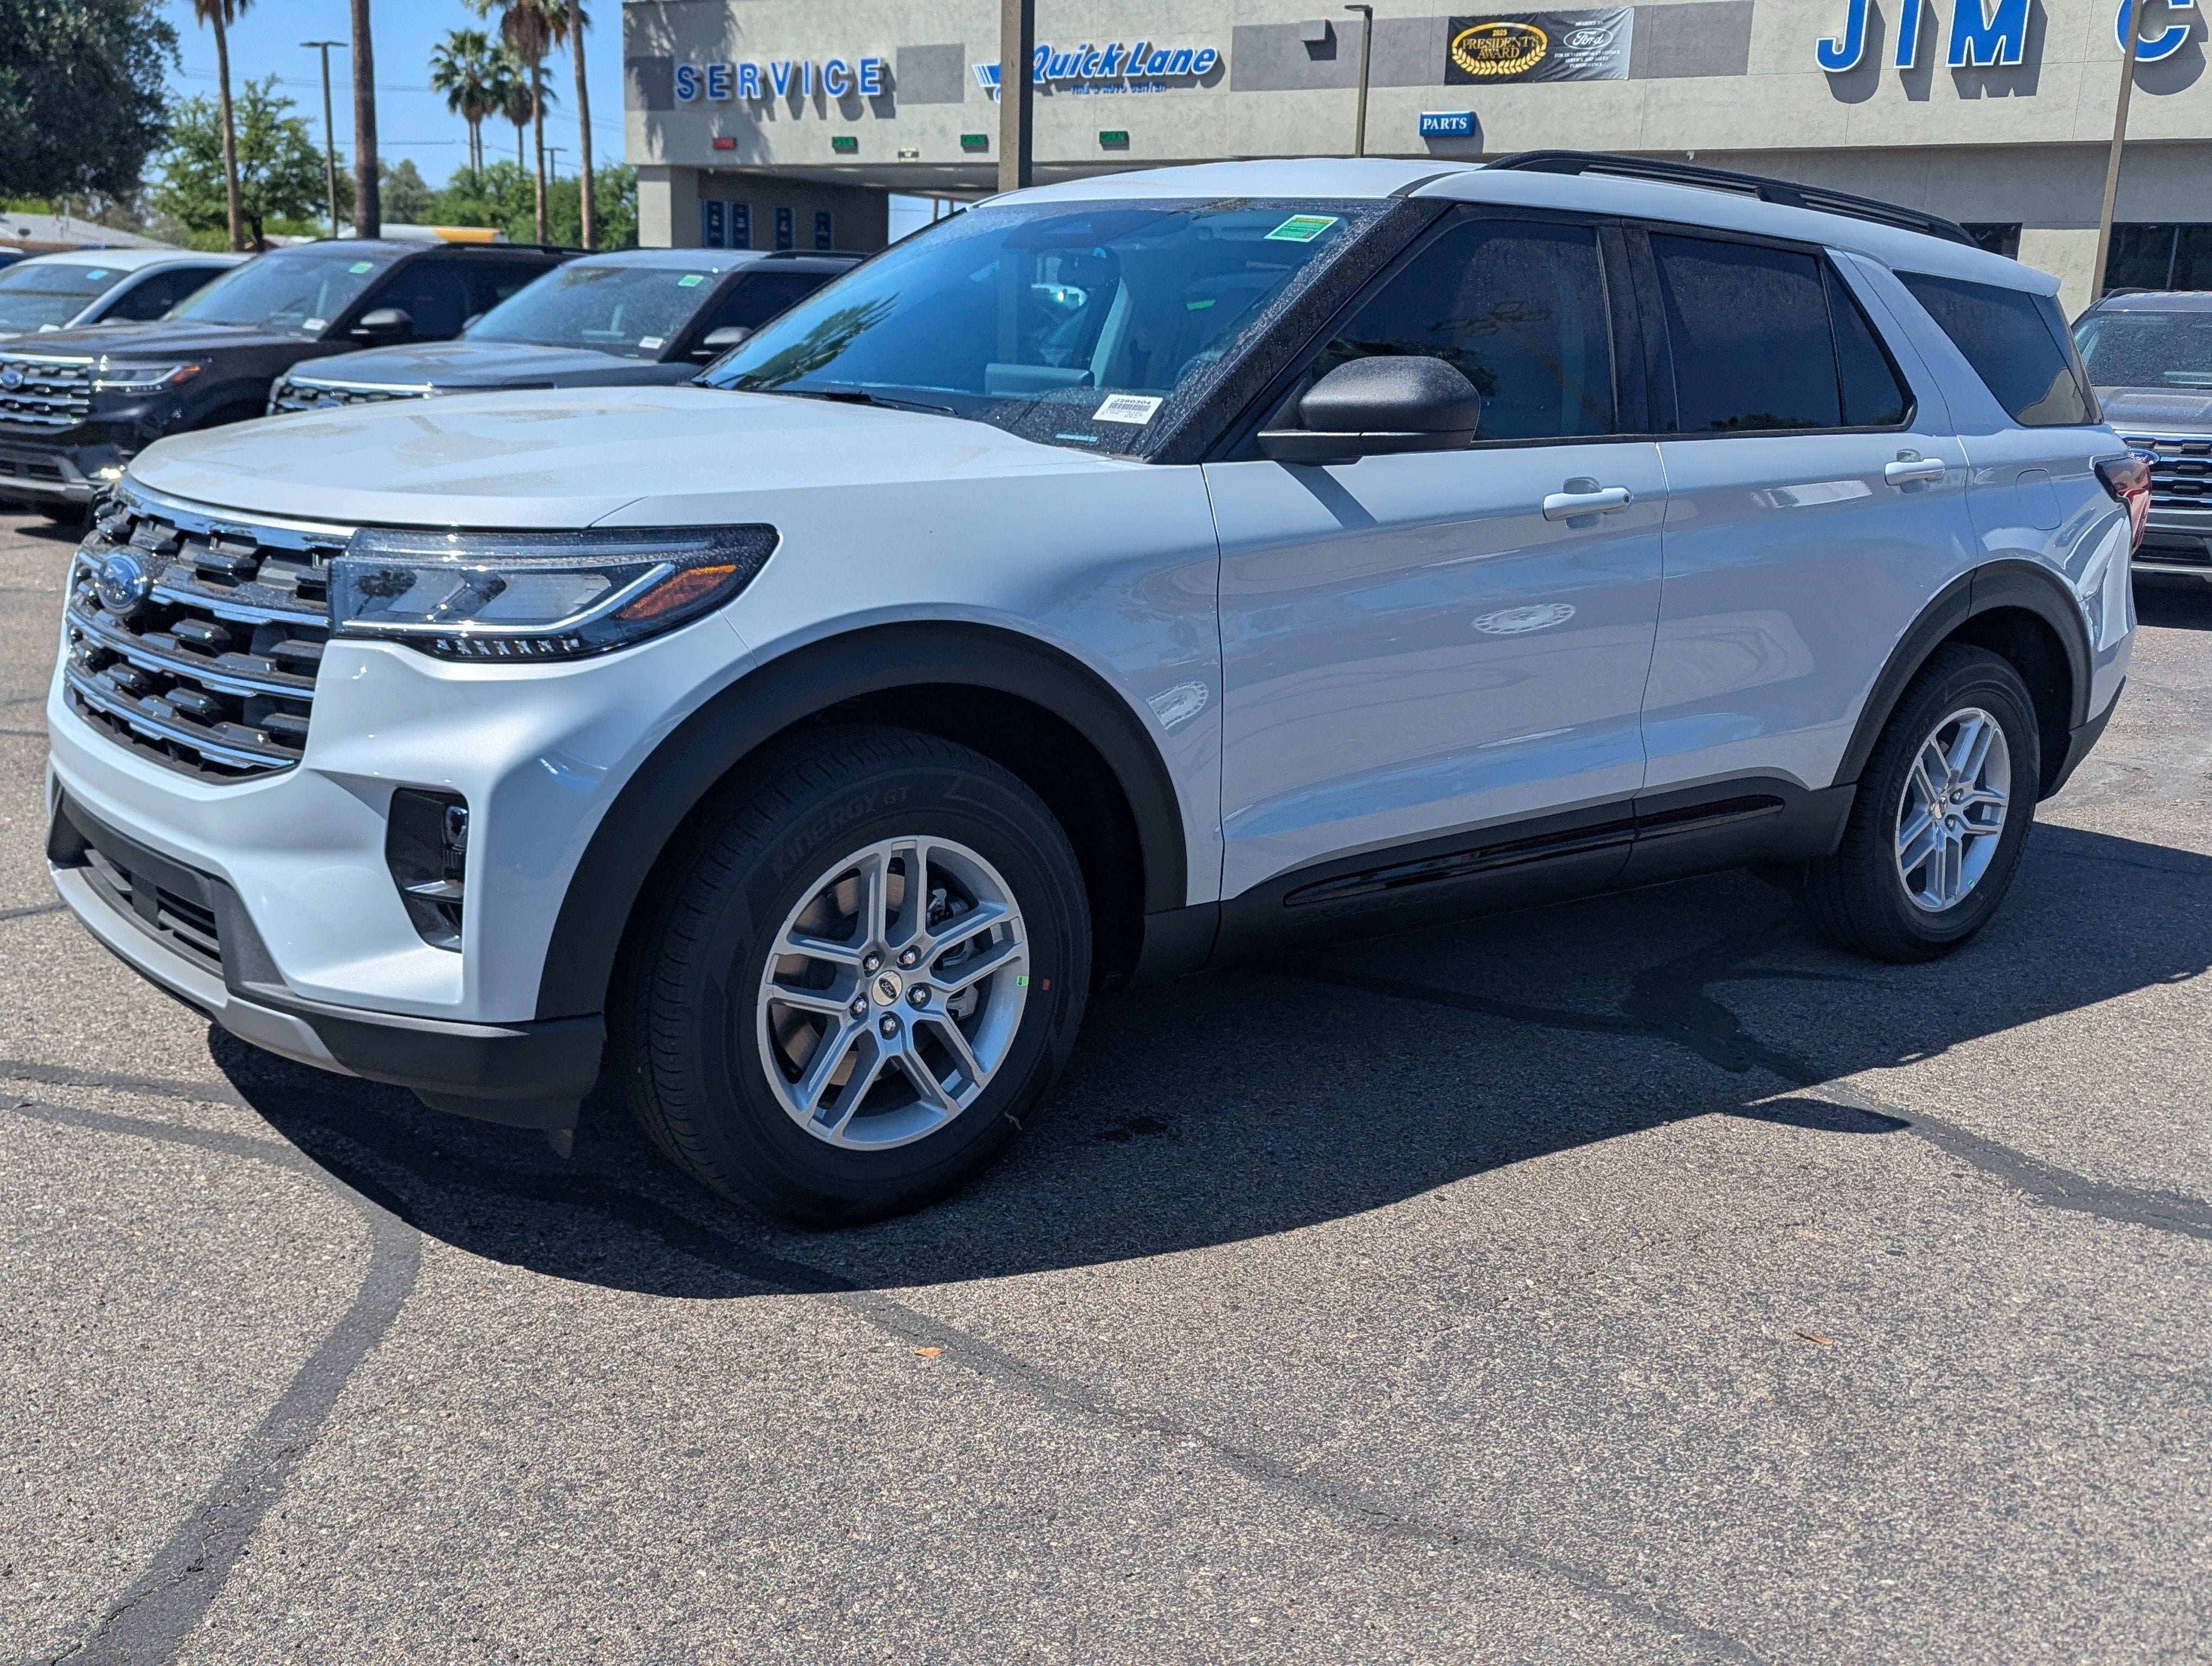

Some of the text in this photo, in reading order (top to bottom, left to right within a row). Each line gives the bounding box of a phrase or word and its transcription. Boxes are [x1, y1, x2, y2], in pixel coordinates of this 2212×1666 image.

[1462, 35, 1539, 49] PRESIDENT'S
[1572, 31, 1604, 46] Ford
[1815, 0, 2030, 72] JIM
[1477, 45, 1520, 60] AWARD
[1033, 41, 1218, 84] Quick Lane
[674, 56, 881, 102] SERVICE
[1423, 117, 1467, 130] PARTS
